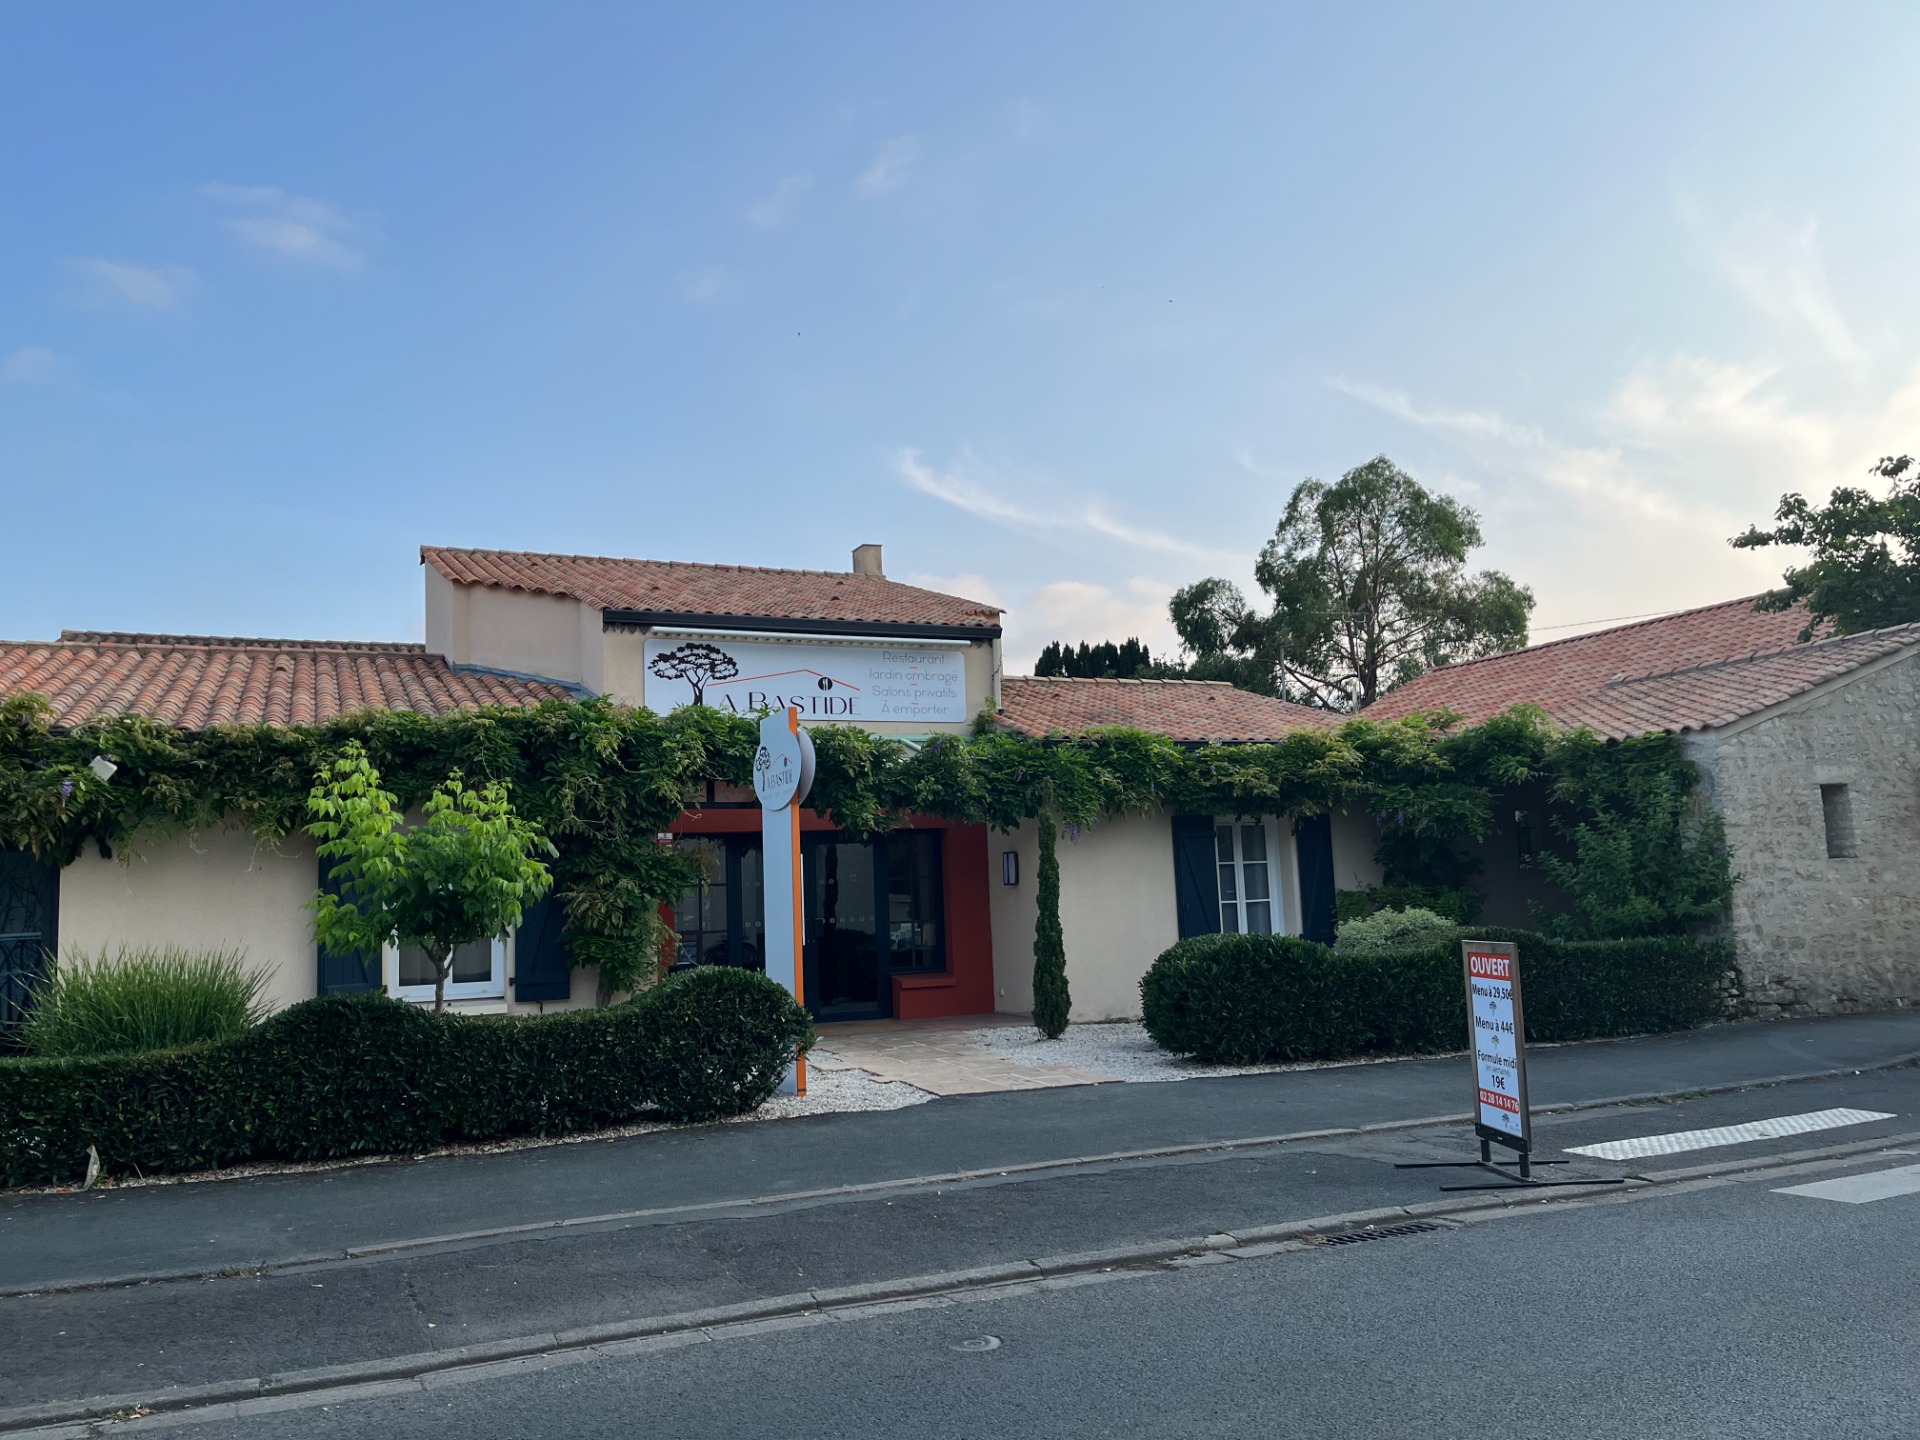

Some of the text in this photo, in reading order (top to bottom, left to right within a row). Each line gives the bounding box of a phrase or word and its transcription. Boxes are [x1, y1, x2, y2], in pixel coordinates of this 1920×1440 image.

[883, 651, 944, 664] Restaurant
[905, 670, 958, 686] ombragé
[872, 685, 957, 701] Salons privatifs
[748, 691, 862, 716] BASTIDE
[893, 704, 948, 718] emporter
[1470, 956, 1510, 977] OUVERT
[1472, 983, 1488, 996] Menu
[1475, 1016, 1514, 1035] Menu à 44€
[1477, 1049, 1518, 1070] Formule midi
[1492, 1075, 1505, 1090] 19€
[1480, 1090, 1487, 1101] 02
[1496, 1095, 1503, 1107] 14
[1503, 1097, 1511, 1109] 14
[1511, 1100, 1519, 1112] 76
